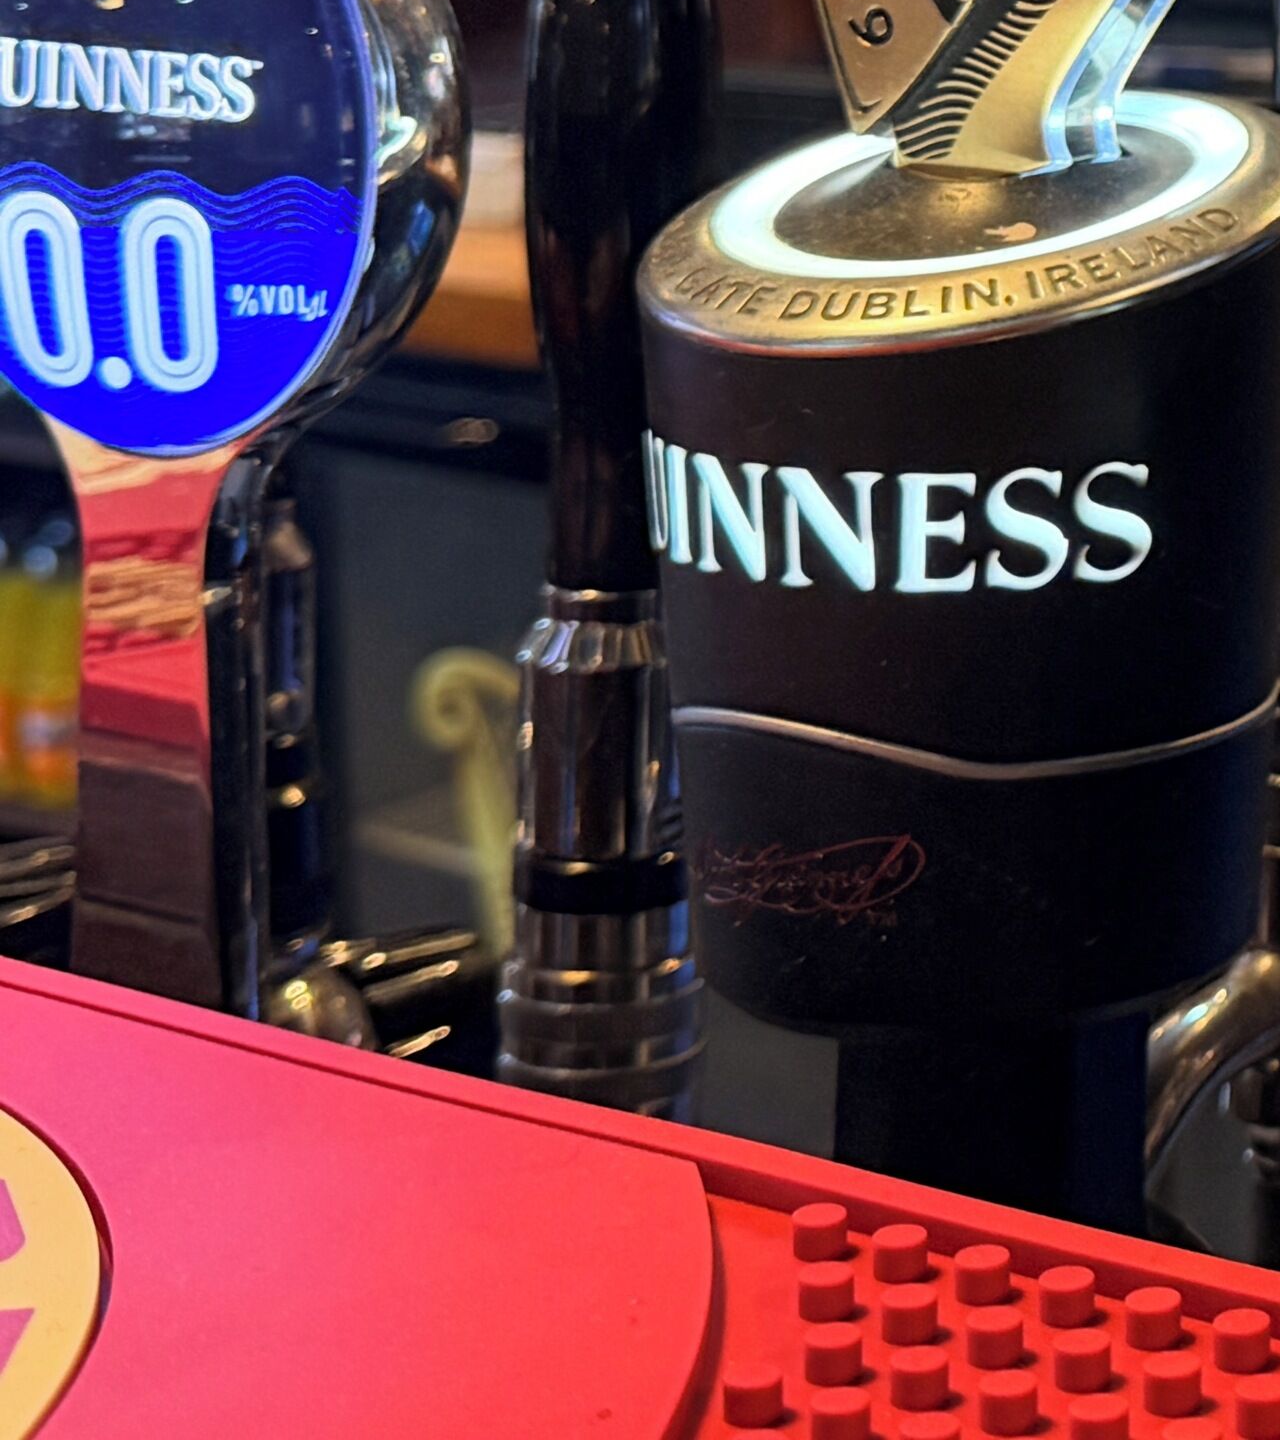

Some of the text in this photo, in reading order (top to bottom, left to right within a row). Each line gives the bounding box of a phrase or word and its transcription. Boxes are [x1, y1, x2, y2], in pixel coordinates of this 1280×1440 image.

[0, 190, 219, 393] 0.0
[674, 266, 778, 316] GATE
[1026, 206, 1241, 298] IRELAND
